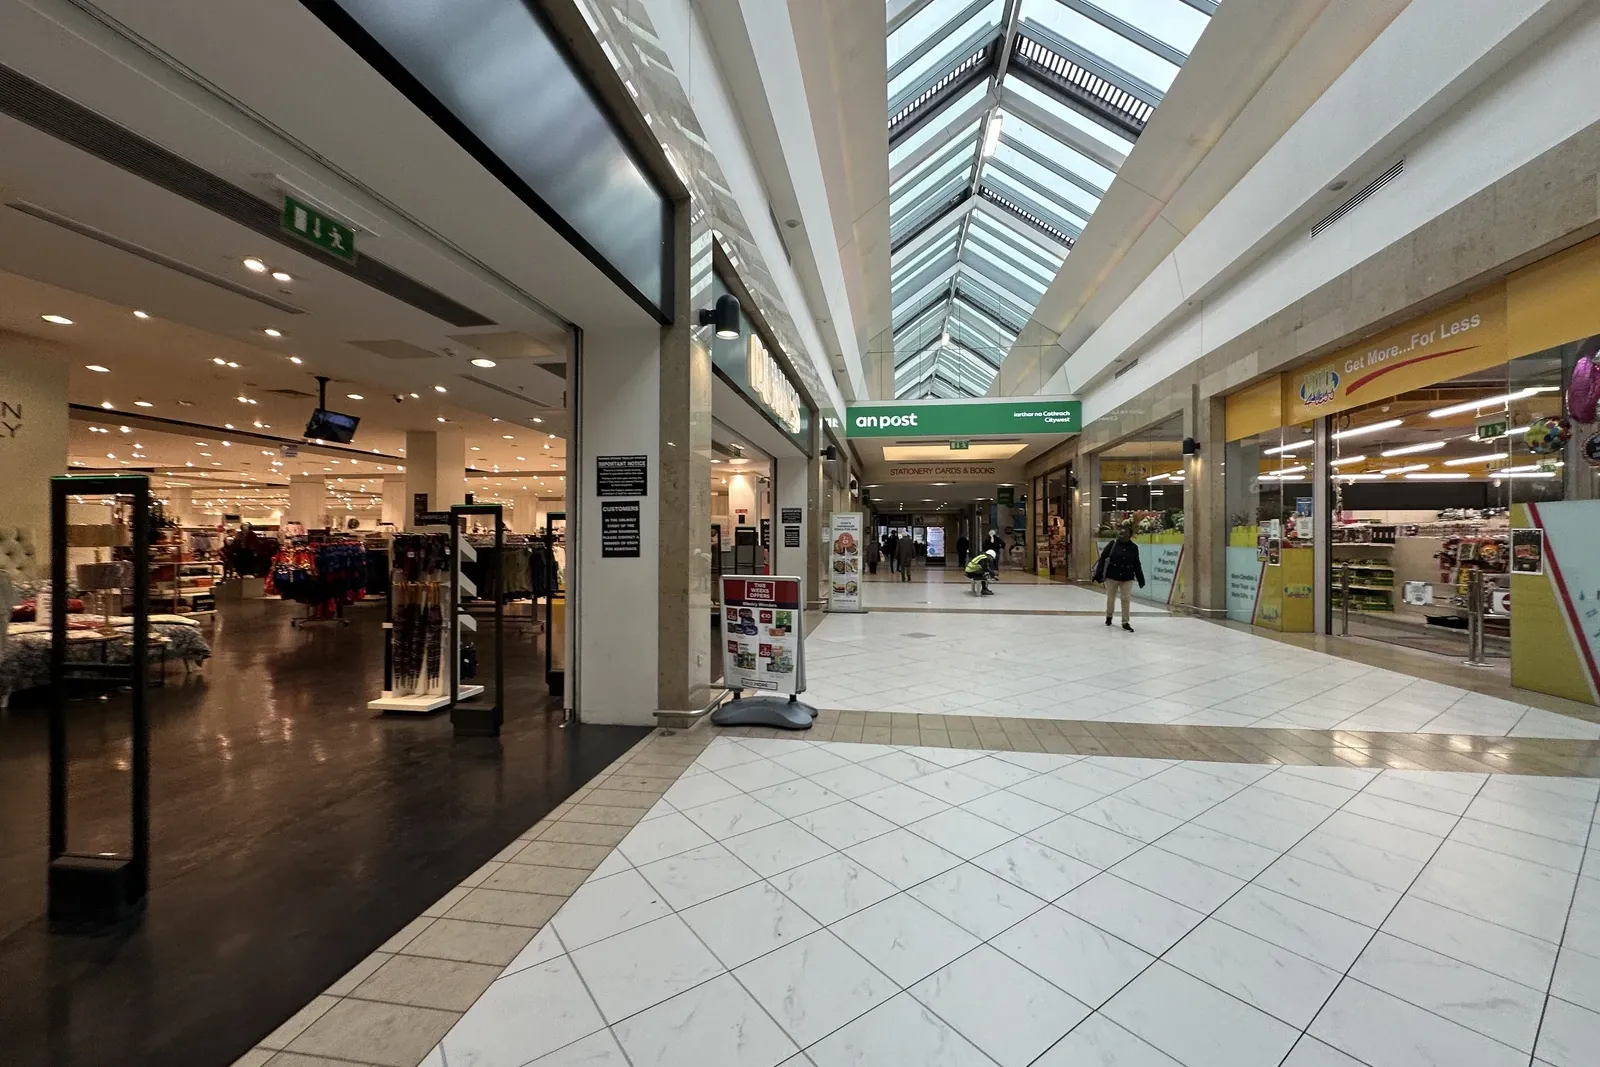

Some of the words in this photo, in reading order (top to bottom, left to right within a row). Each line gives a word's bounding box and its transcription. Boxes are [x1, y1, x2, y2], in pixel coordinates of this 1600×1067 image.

[1344, 356, 1365, 374] Get
[1440, 313, 1481, 339] Less
[855, 416, 878, 428] an
[879, 413, 918, 429] post
[889, 467, 933, 476] STATIONERY
[935, 466, 961, 475] CARDS
[970, 466, 996, 475] BOOKS
